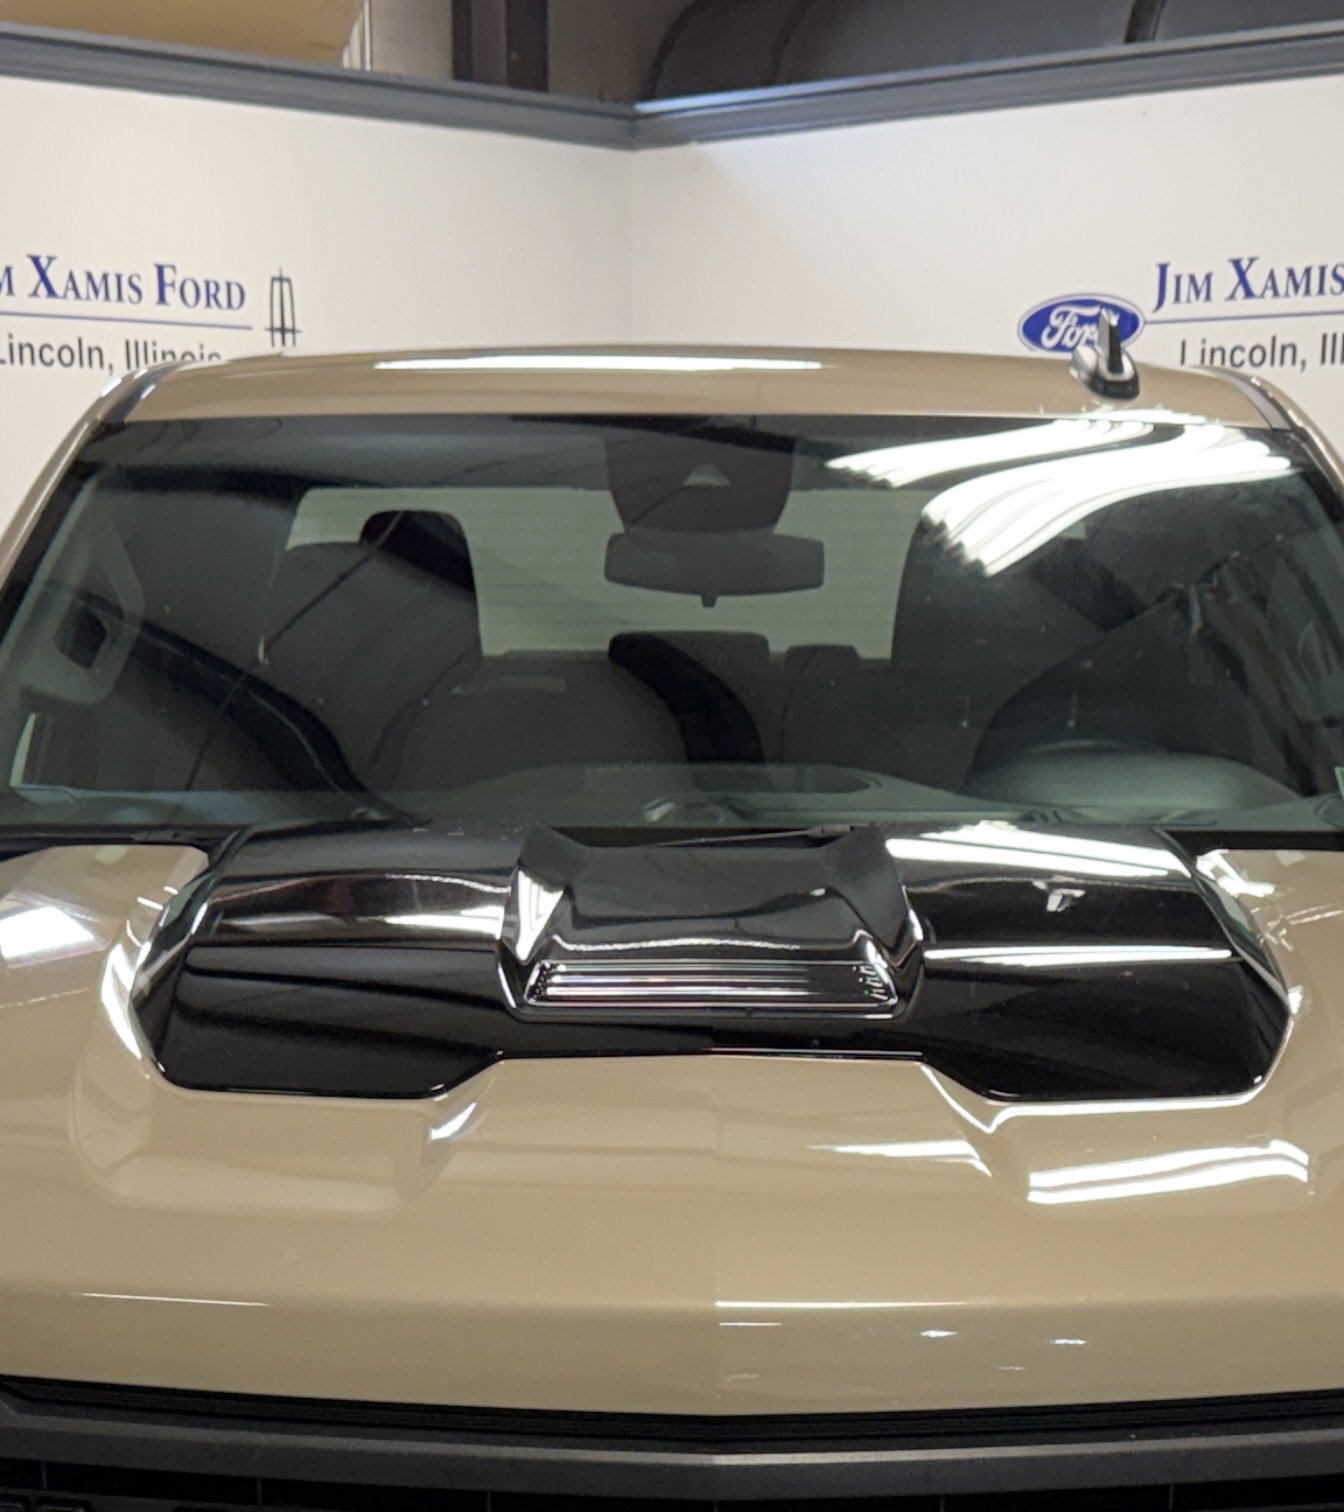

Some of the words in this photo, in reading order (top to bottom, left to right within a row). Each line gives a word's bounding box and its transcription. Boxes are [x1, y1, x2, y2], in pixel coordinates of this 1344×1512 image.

[27, 254, 143, 304] XAMIS
[154, 263, 246, 311] FORD
[1153, 262, 1213, 313] JIM
[1041, 304, 1101, 349] For
